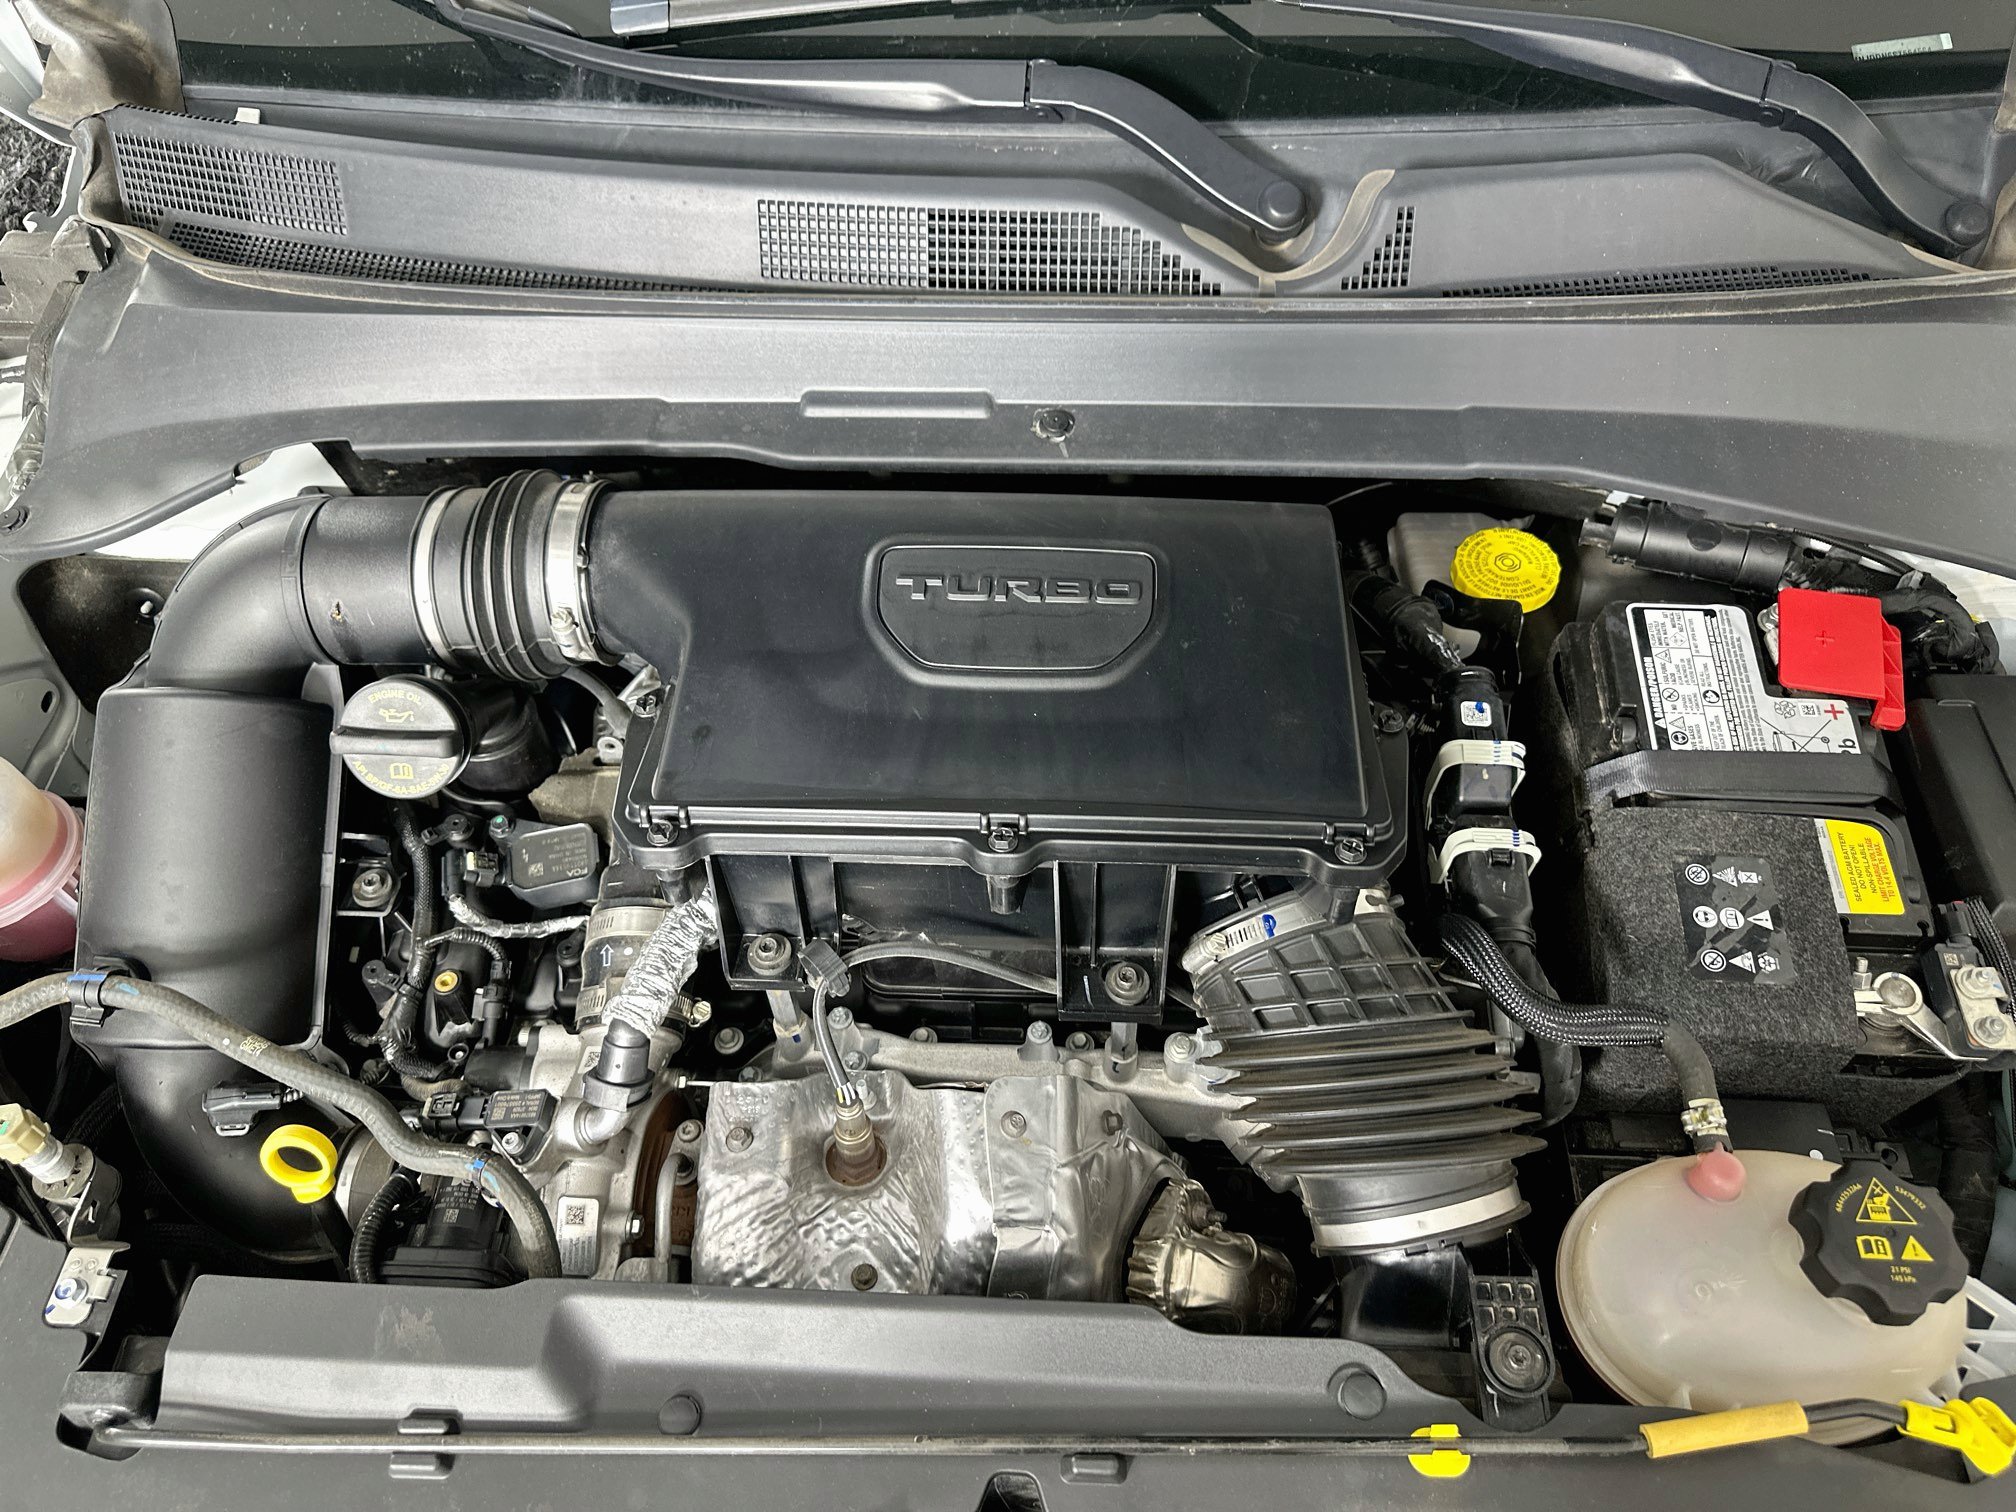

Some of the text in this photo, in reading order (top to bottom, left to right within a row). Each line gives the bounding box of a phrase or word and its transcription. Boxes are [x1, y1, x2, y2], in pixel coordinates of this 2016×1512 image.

[895, 574, 1142, 605] TURBO
[1659, 661, 1669, 682] SULFURIC
[1642, 656, 1664, 717] DANGER/POISON
[367, 689, 421, 706] ENGINE OIL
[566, 867, 588, 877] FCA
[1836, 832, 1862, 901] SEALED AGM BATTERY
[1847, 844, 1866, 888] DO NOT OPEN!
[1857, 843, 1877, 893] NON-SPILLABLE
[1864, 837, 1889, 901] LIMIT CHARGE VOLTAGE
[1877, 857, 1889, 874] VOLTS
[1883, 876, 1892, 887] 14.4
[1887, 889, 1895, 897] TO
[1890, 1265, 1899, 1273] 21
[1890, 1274, 1917, 1283] 145 kPa
